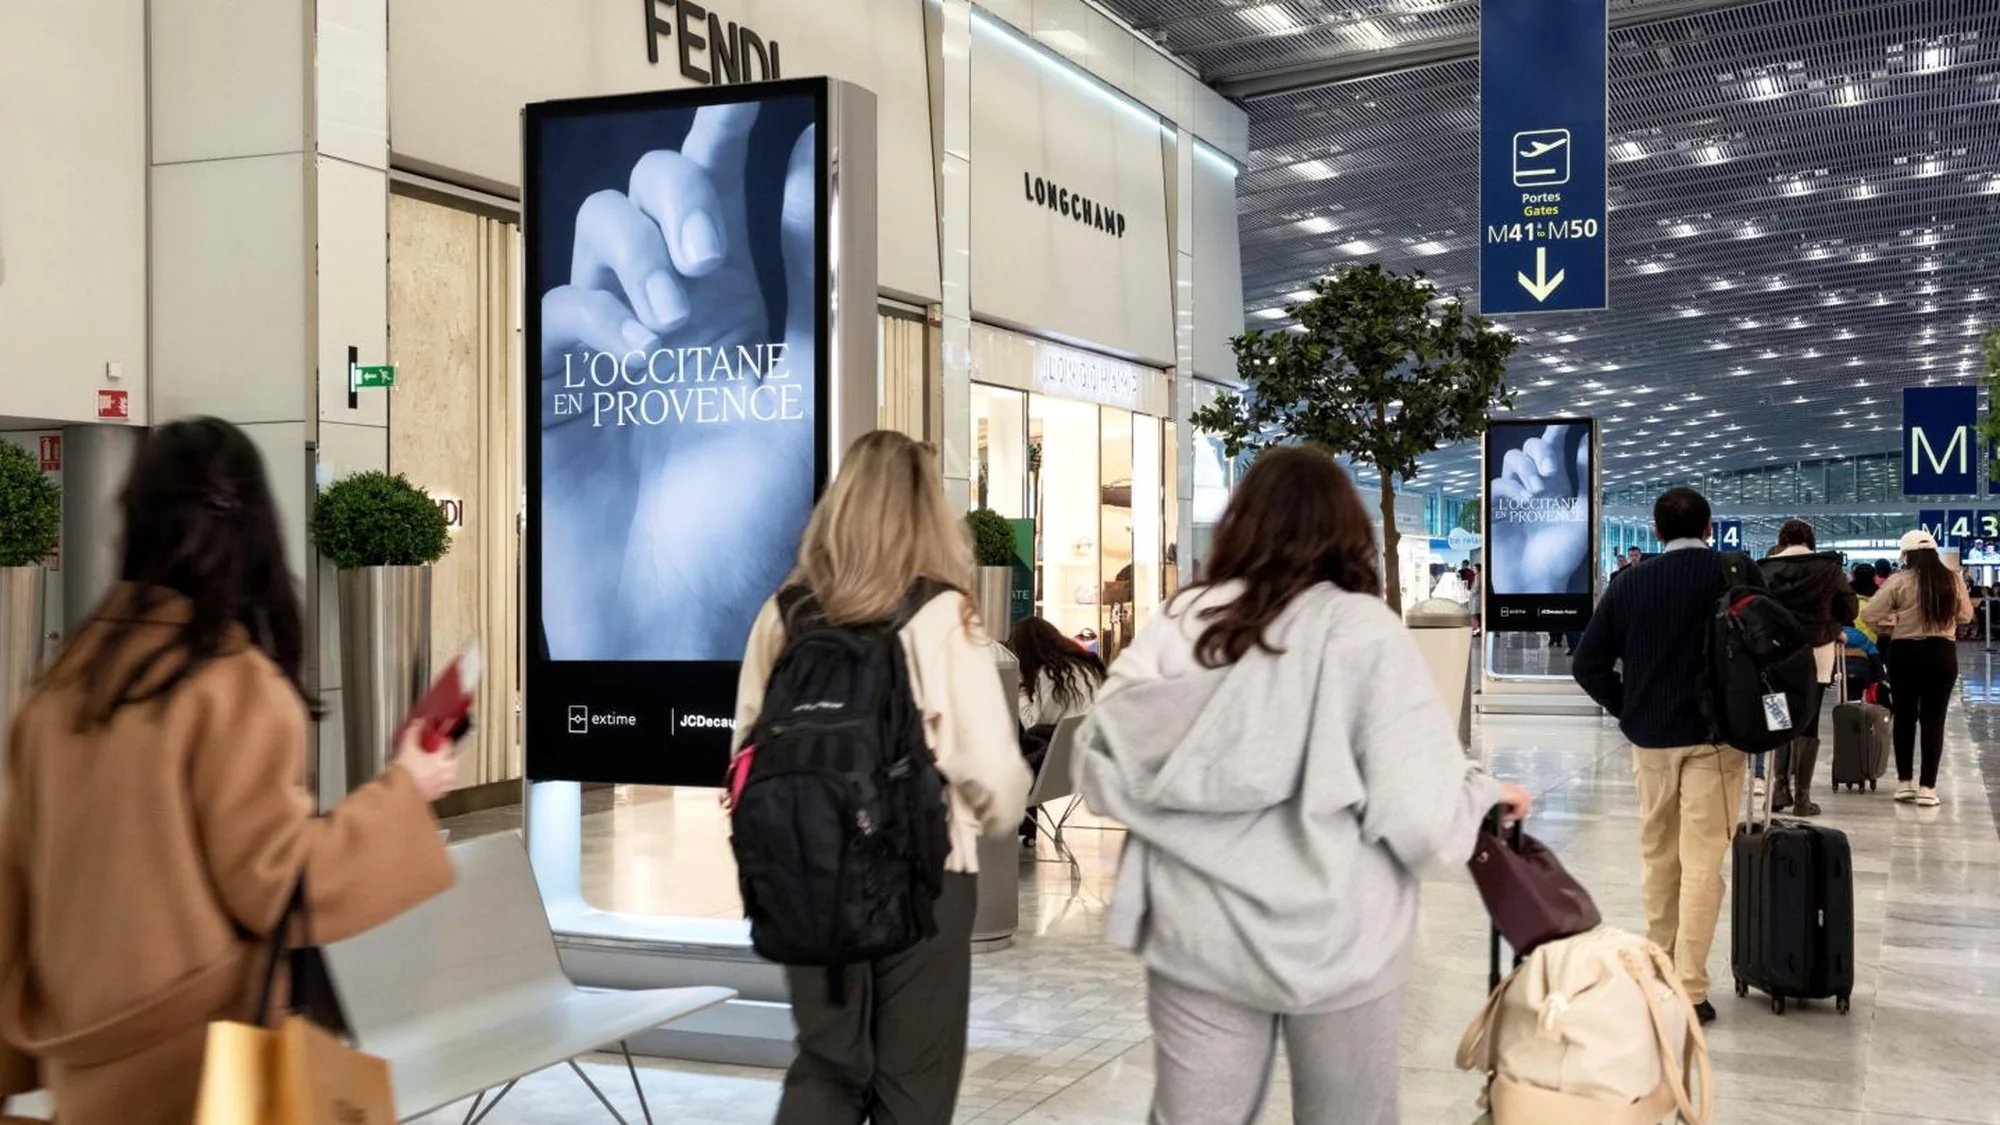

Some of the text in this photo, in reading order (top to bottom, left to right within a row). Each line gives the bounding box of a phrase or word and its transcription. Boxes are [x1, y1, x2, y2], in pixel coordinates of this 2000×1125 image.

[1024, 171, 1125, 238] LONGCHAMP
[1522, 192, 1561, 203] Portes
[1524, 205, 1559, 216] Gates
[1488, 222, 1534, 243] M41
[1548, 218, 1598, 240] M50
[563, 343, 790, 388] L'OCCITANE
[554, 383, 803, 427] EN PROVENCE
[1912, 425, 1967, 475] M
[592, 711, 737, 729] extime JCDecau
